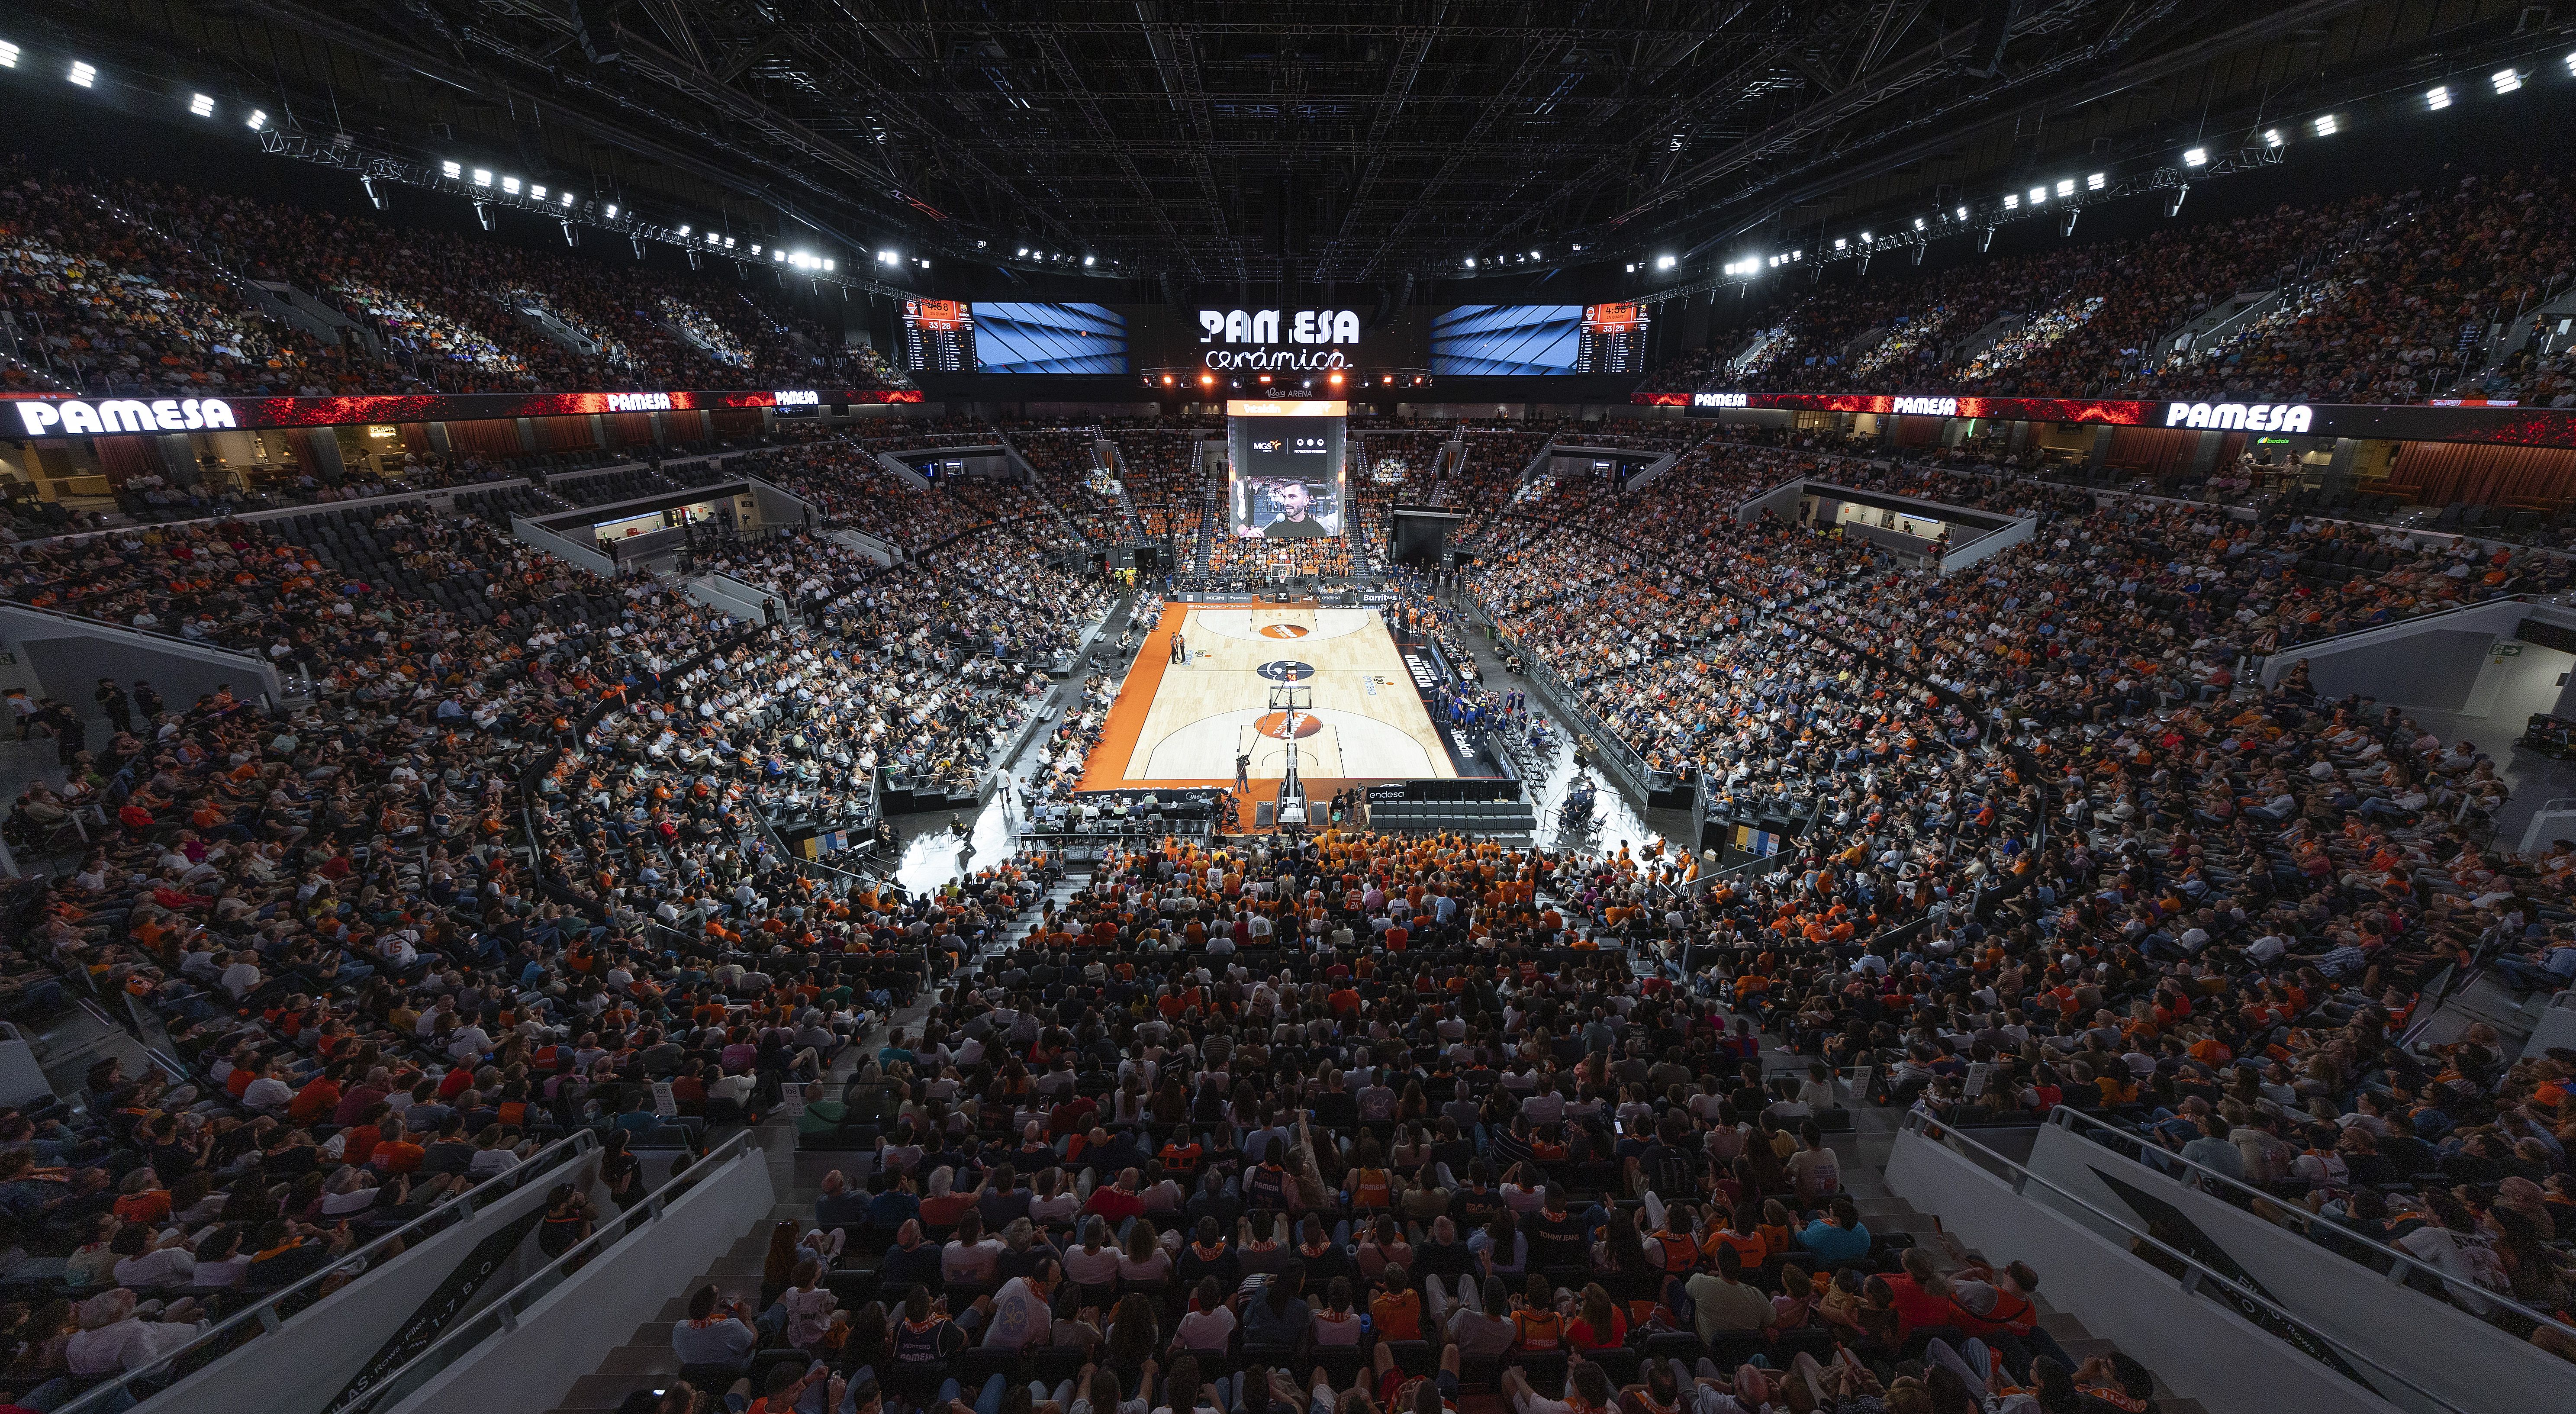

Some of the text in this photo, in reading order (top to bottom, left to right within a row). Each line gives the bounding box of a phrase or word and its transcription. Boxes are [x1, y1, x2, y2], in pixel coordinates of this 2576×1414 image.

[608, 393, 671, 412] PAMESA
[775, 390, 819, 406] PAMESA
[1694, 393, 1747, 407] PAMESA
[1893, 397, 1957, 416] PAMESA
[16, 399, 237, 436] PAMESA
[2166, 402, 2312, 432] PAMESA
[1404, 654, 1434, 688] VALENCIA
[1500, 752, 1516, 780] Barrit
[389, 941, 402, 955] 15
[1254, 1181, 1279, 1192] PAMESA
[1539, 1230, 1562, 1241] TOMMY
[2287, 1324, 2316, 1353] Rows
[373, 1346, 401, 1376] Rows
[900, 1353, 934, 1362] PAMESA
